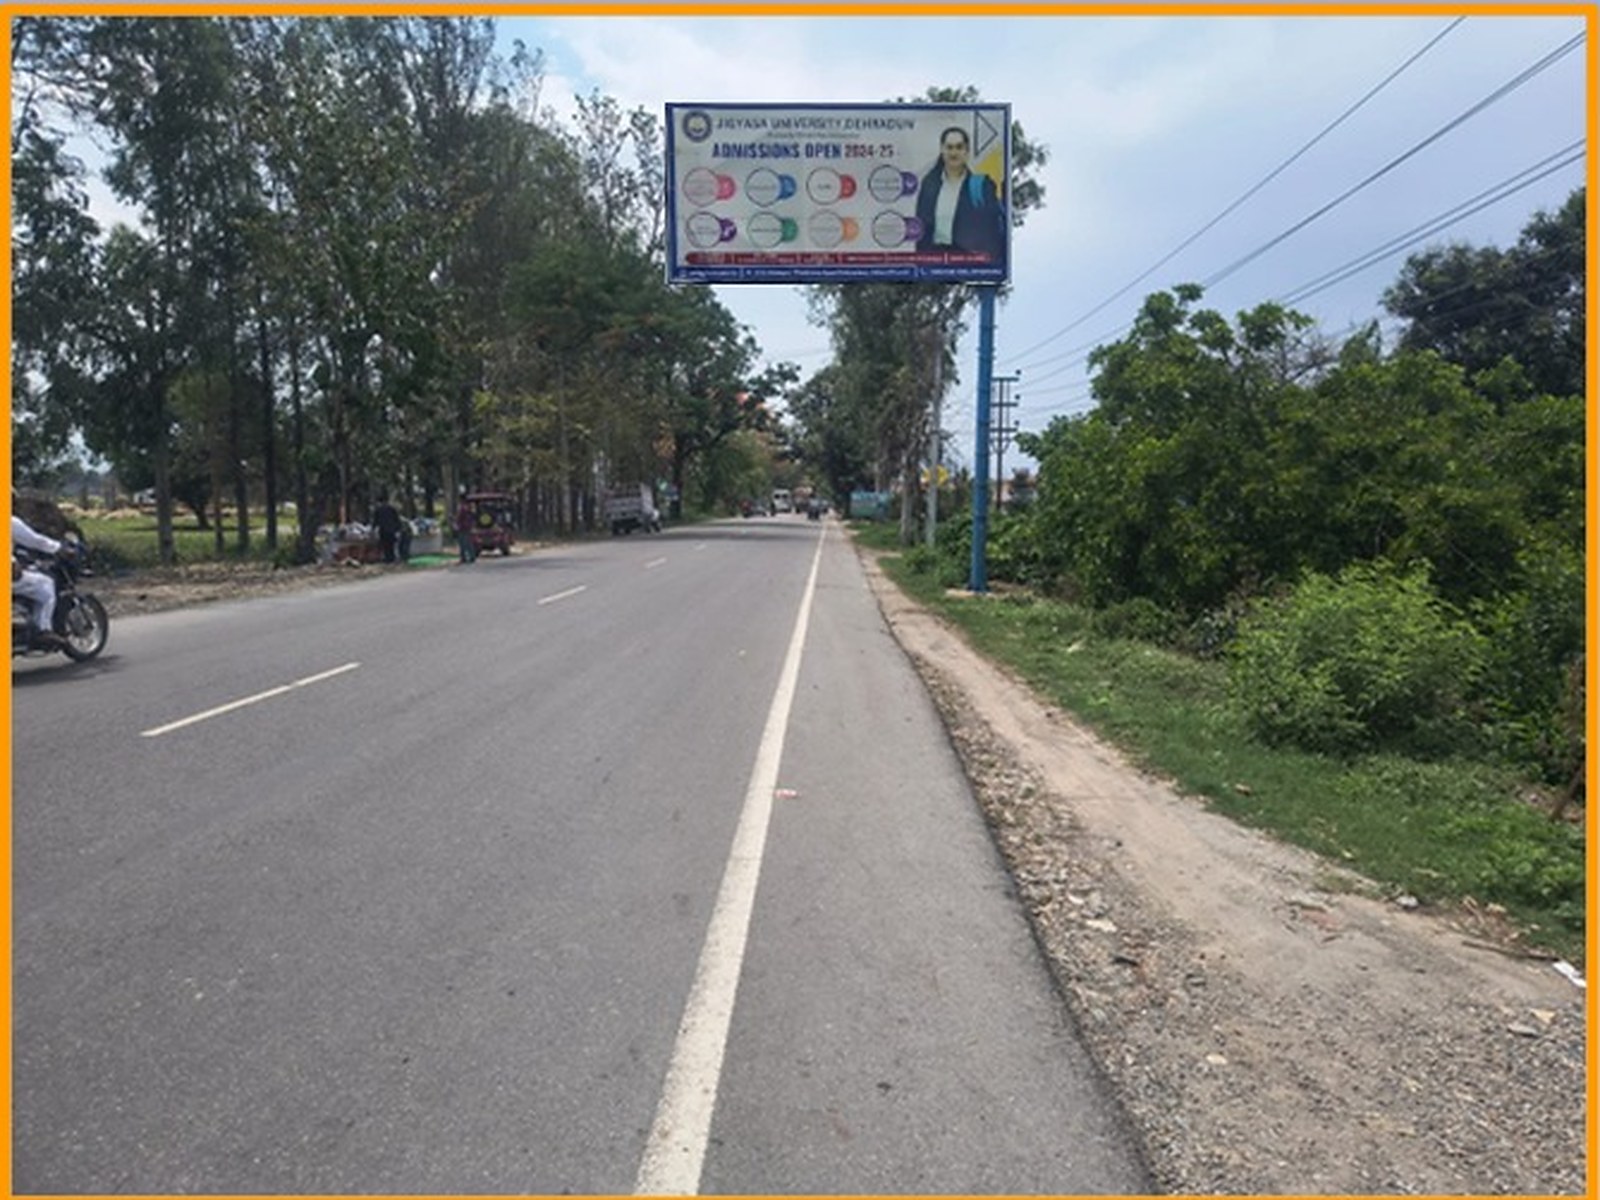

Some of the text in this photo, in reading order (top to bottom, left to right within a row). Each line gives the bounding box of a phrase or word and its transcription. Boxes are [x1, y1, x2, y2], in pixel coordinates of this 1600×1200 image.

[717, 118, 768, 129] JIGYASA
[712, 142, 895, 159] ADMISSIONS OPEN 2024-25
